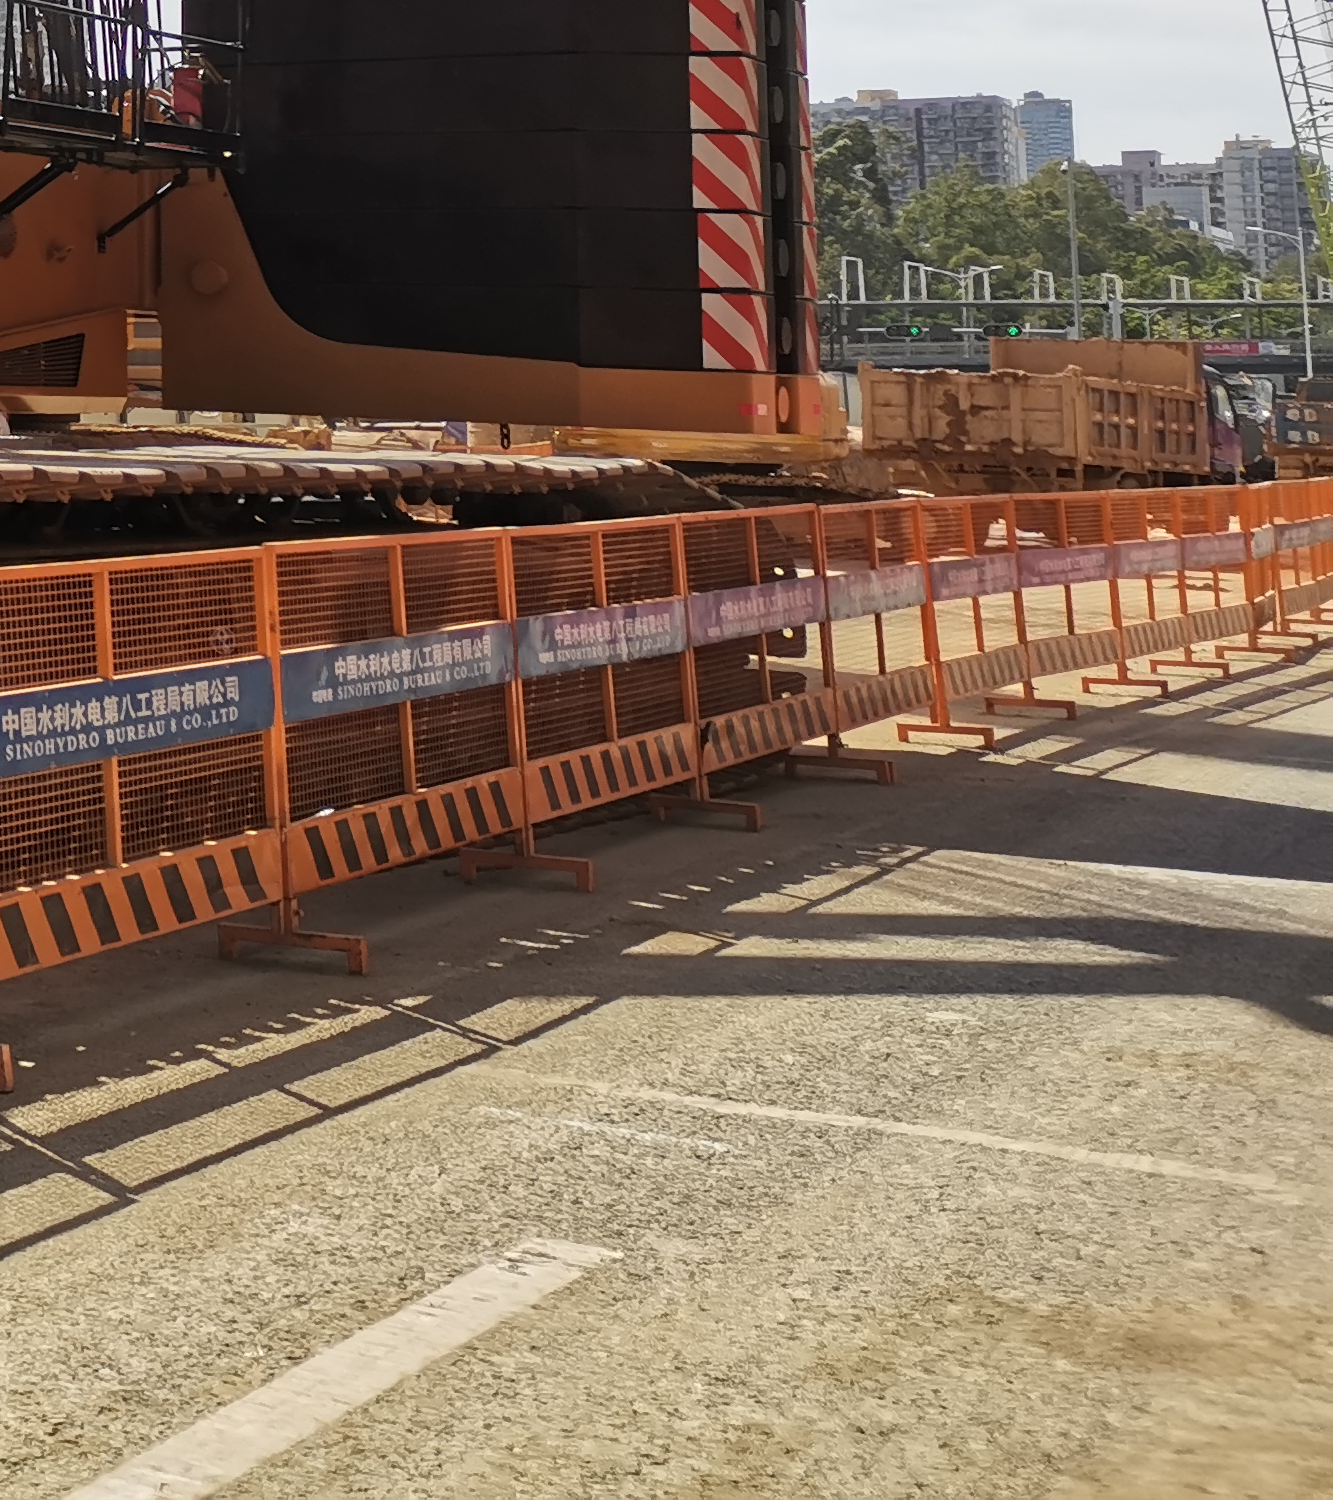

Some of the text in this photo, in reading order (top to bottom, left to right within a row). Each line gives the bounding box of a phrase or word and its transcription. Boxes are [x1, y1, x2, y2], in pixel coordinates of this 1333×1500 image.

[334, 634, 491, 683] 中国水利水电第八工程局有限公司
[1, 676, 240, 741] 中国水利水电第八工程局有限公司
[5, 731, 100, 762] SINOHYDRO
[106, 719, 166, 745] BUREAU
[182, 706, 239, 731] CO.,LTD
